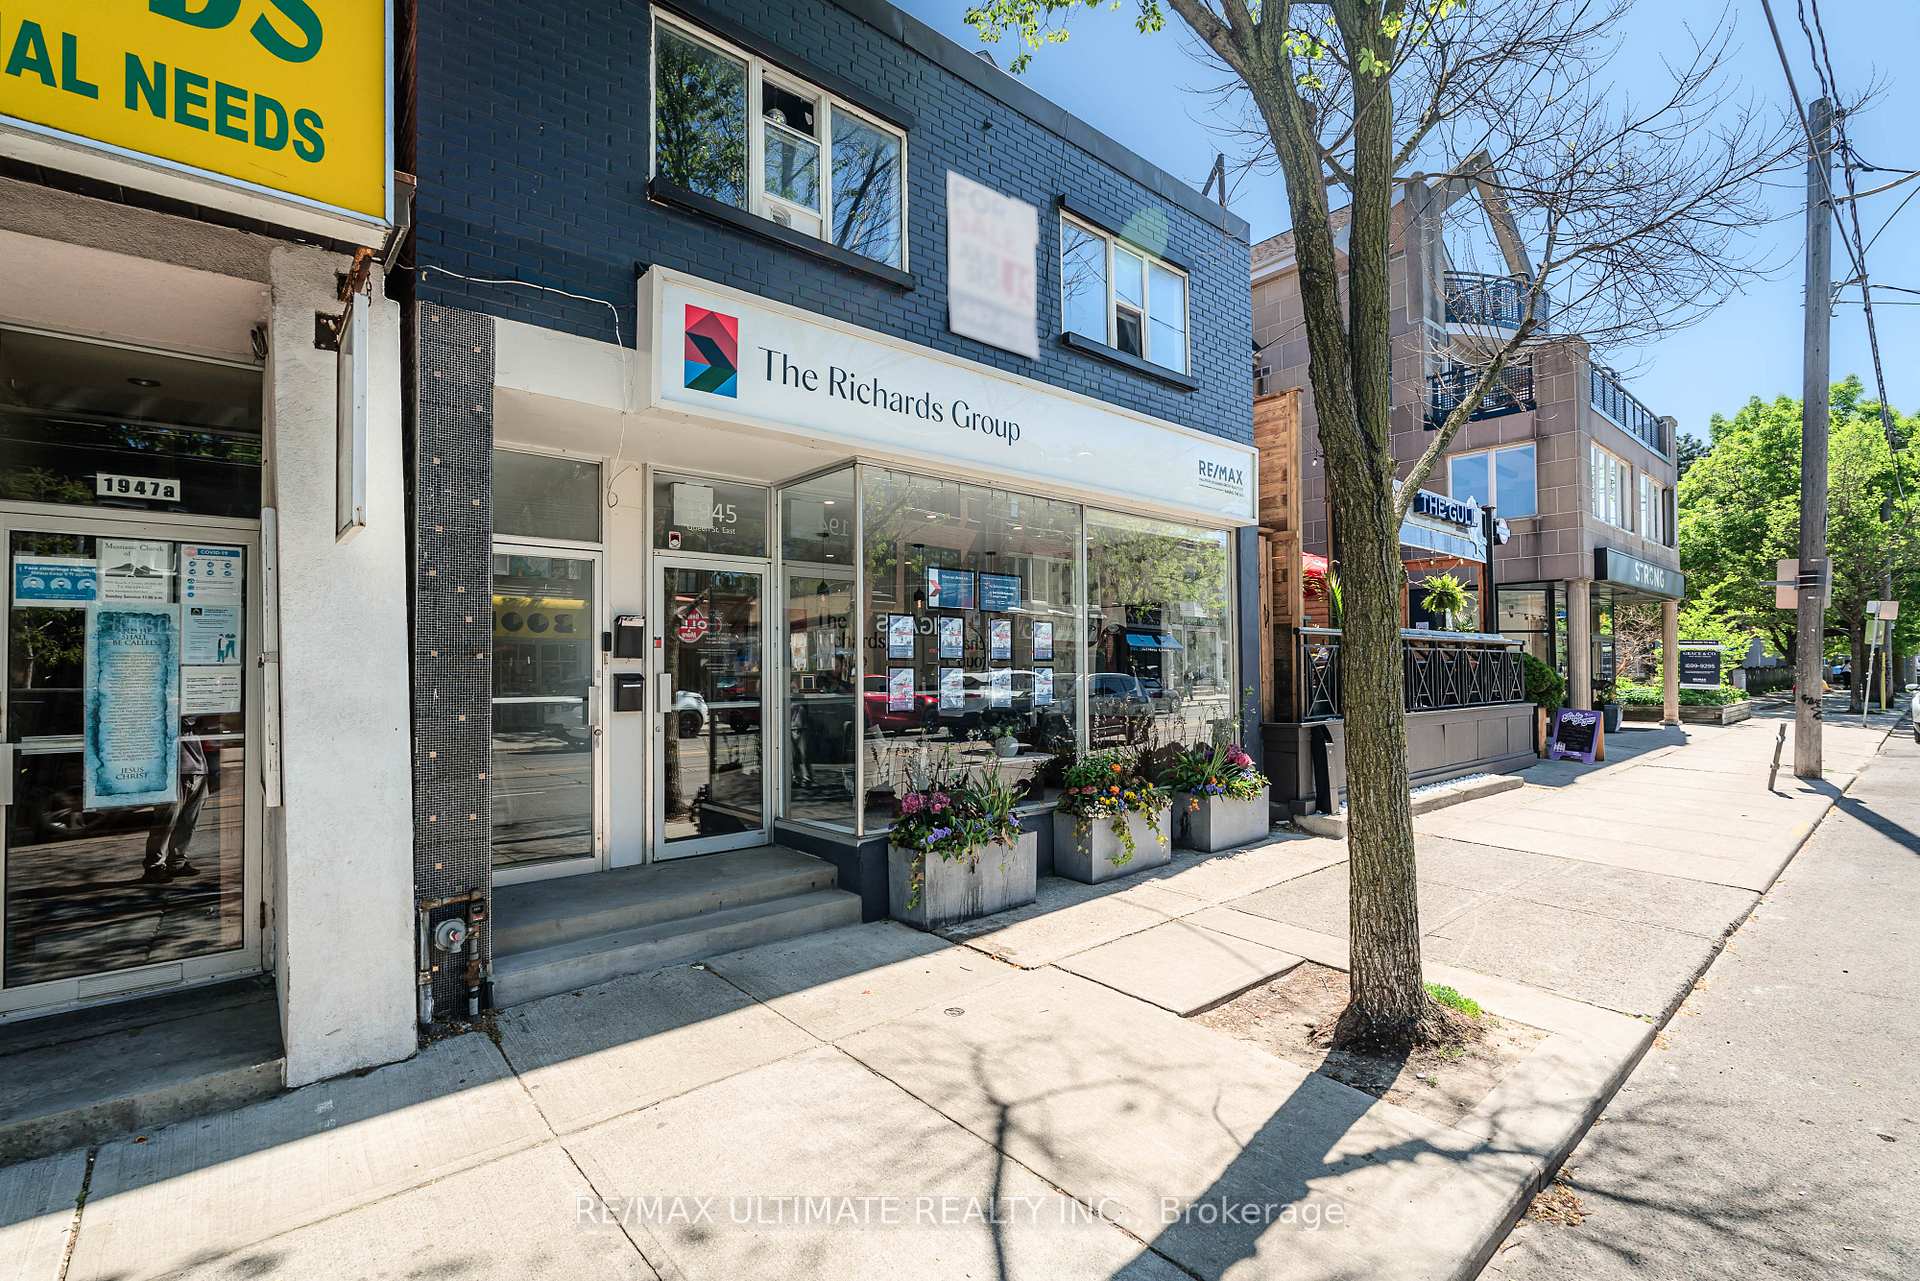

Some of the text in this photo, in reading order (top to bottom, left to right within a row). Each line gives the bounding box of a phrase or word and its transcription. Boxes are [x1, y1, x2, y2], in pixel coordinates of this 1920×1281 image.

[125, 52, 326, 163] NEEDS
[757, 345, 1021, 446] The Richards Group
[1198, 459, 1243, 485] RE/MAX
[103, 477, 175, 498] 1947a
[1421, 493, 1447, 517] THE
[1634, 561, 1665, 588] STRONG
